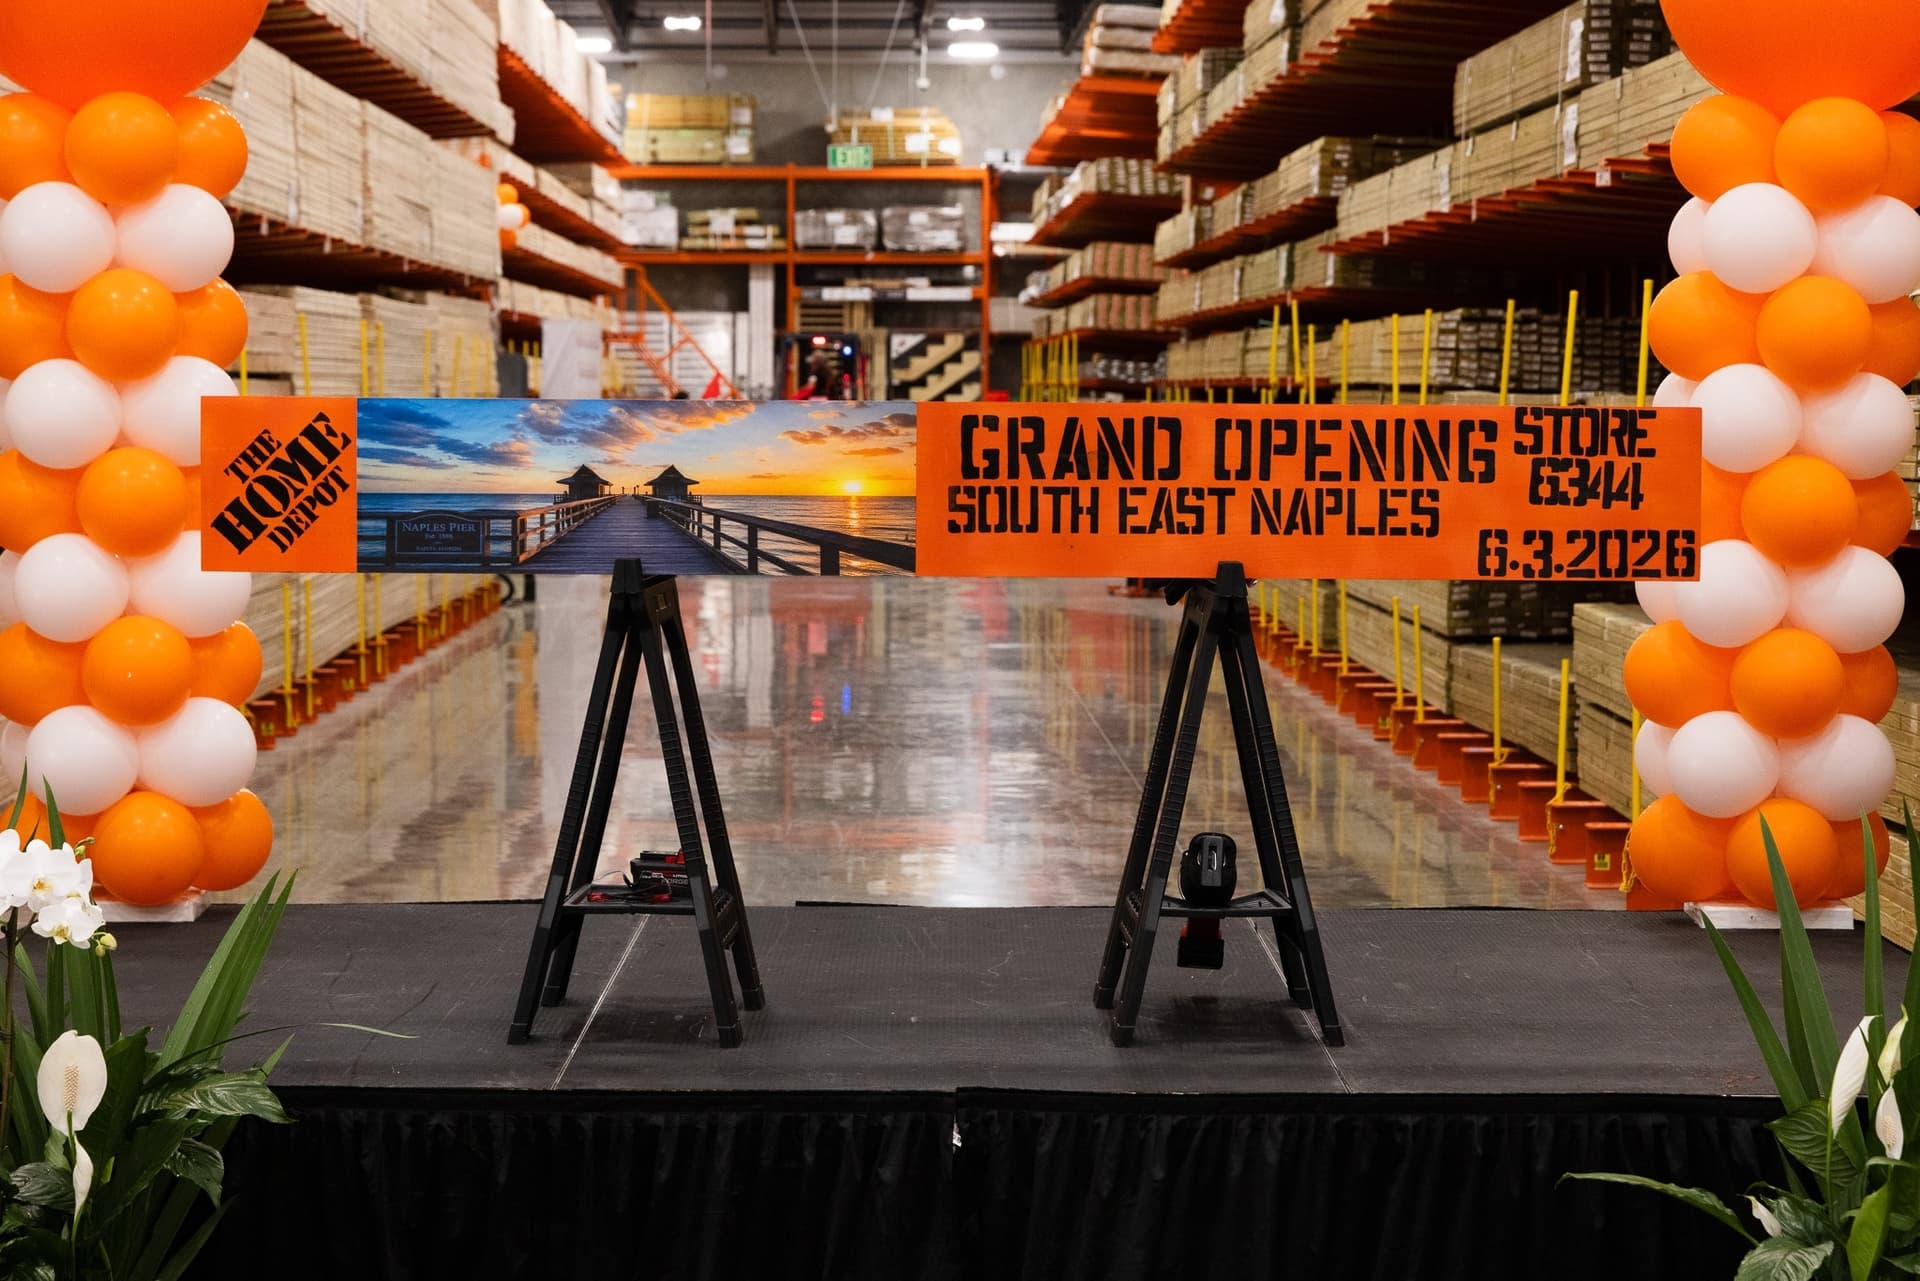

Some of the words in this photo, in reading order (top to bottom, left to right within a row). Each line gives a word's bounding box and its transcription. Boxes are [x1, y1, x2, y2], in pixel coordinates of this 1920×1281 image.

[224, 428, 282, 485] THE
[961, 415, 1181, 481] GRAND
[1214, 418, 1498, 484] OPENING
[1514, 407, 1657, 457] STORE
[210, 411, 352, 555] HOME
[266, 465, 350, 553] DEPOT
[1529, 457, 1645, 510] 6344
[449, 522, 476, 532] PIER
[948, 485, 1100, 534] SOUTH
[1118, 487, 1236, 535] EAST
[1251, 488, 1440, 537] NAPLES
[1478, 529, 1696, 579] 6.3.2026
